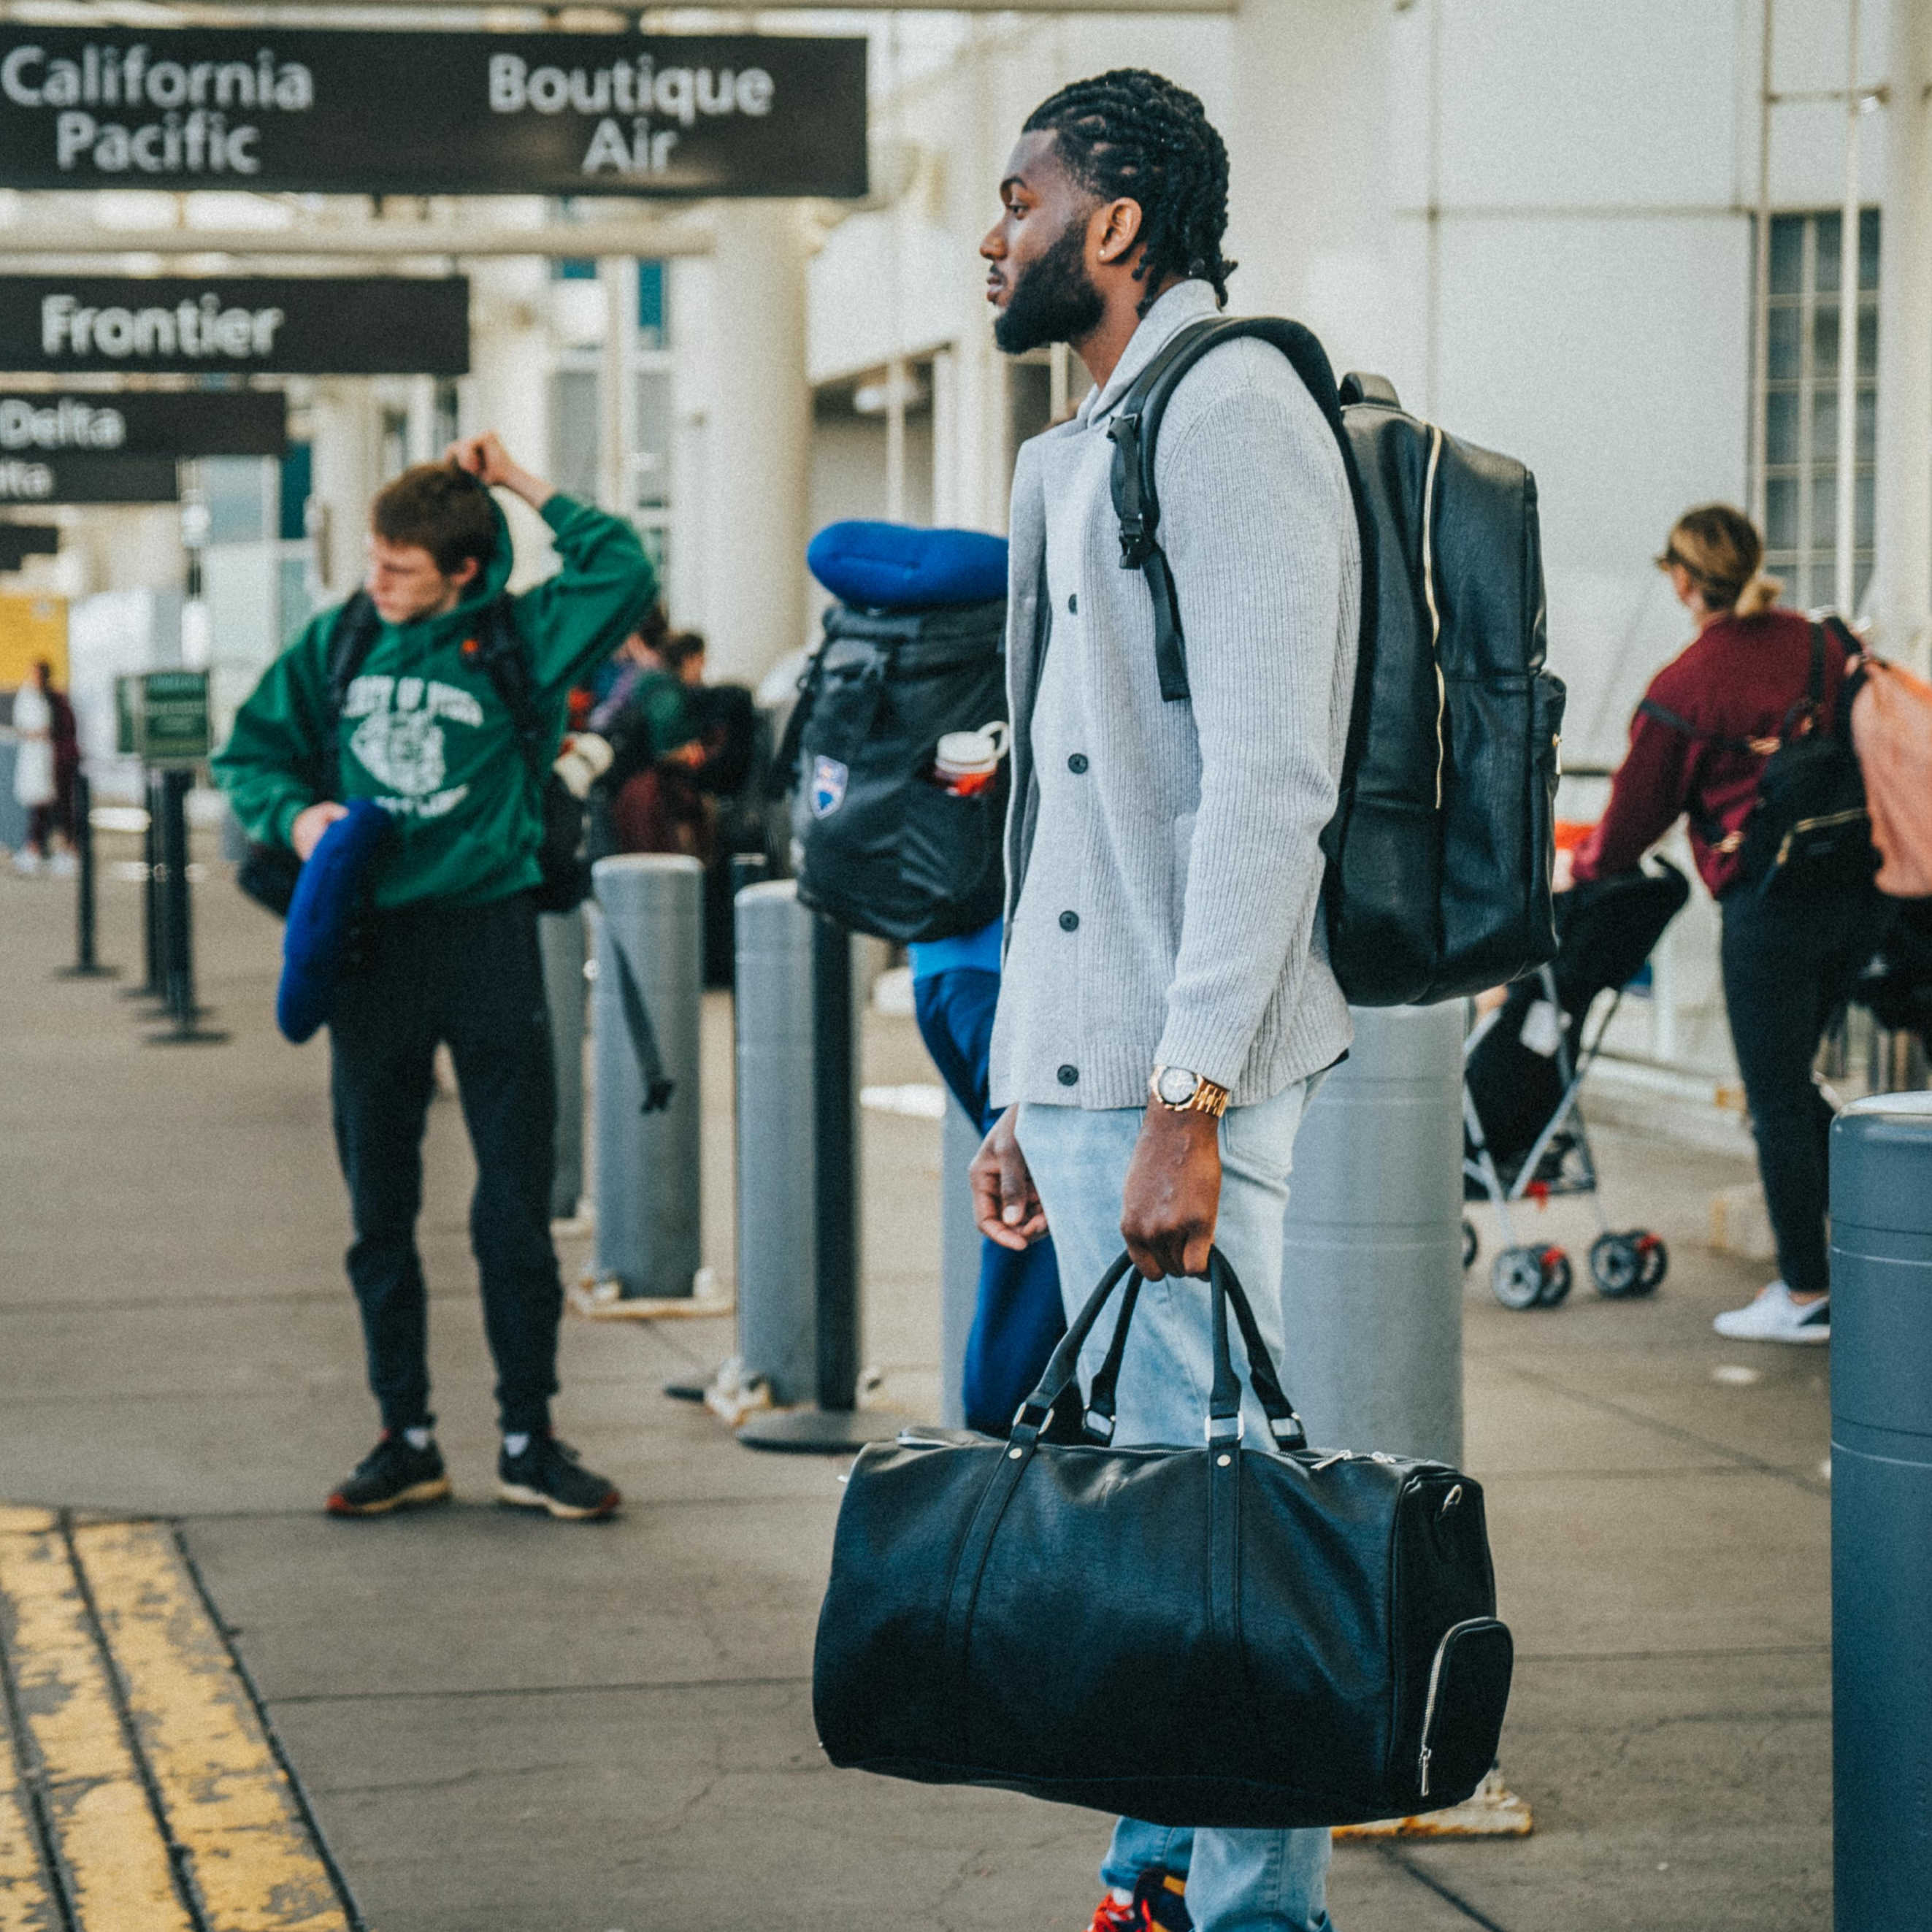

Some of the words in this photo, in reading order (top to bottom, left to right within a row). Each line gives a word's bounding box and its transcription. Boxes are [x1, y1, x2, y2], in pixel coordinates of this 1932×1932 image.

[1, 45, 313, 110] California
[488, 53, 775, 126] Boutique
[57, 110, 259, 173] Pacific
[581, 118, 679, 174] Air
[41, 292, 285, 357] Frontier
[0, 399, 125, 448] Delta
